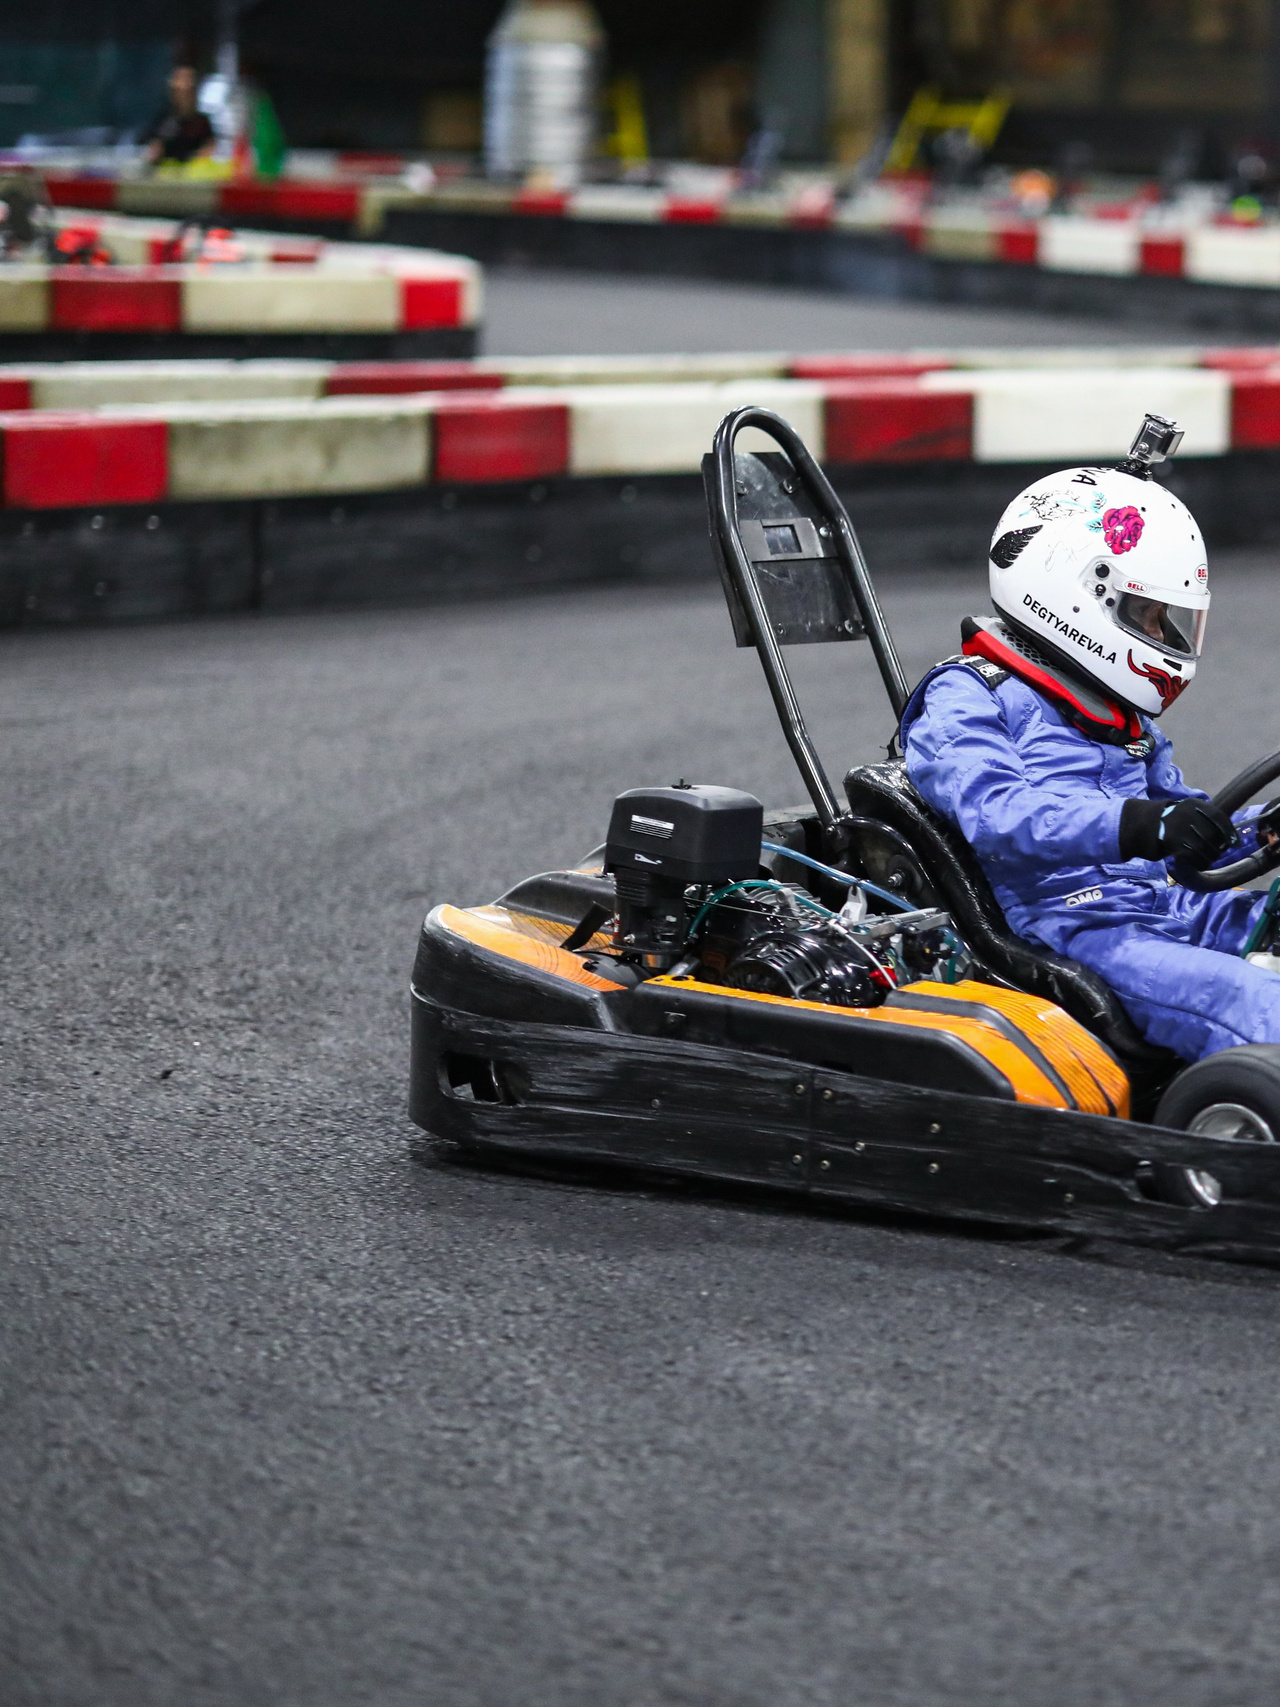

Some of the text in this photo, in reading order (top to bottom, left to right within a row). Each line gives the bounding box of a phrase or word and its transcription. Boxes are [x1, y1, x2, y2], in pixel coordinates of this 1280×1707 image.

[1127, 582, 1145, 592] BELL
[1022, 593, 1117, 665] DEGTYAREVA.A
[1064, 888, 1104, 907] OMP
